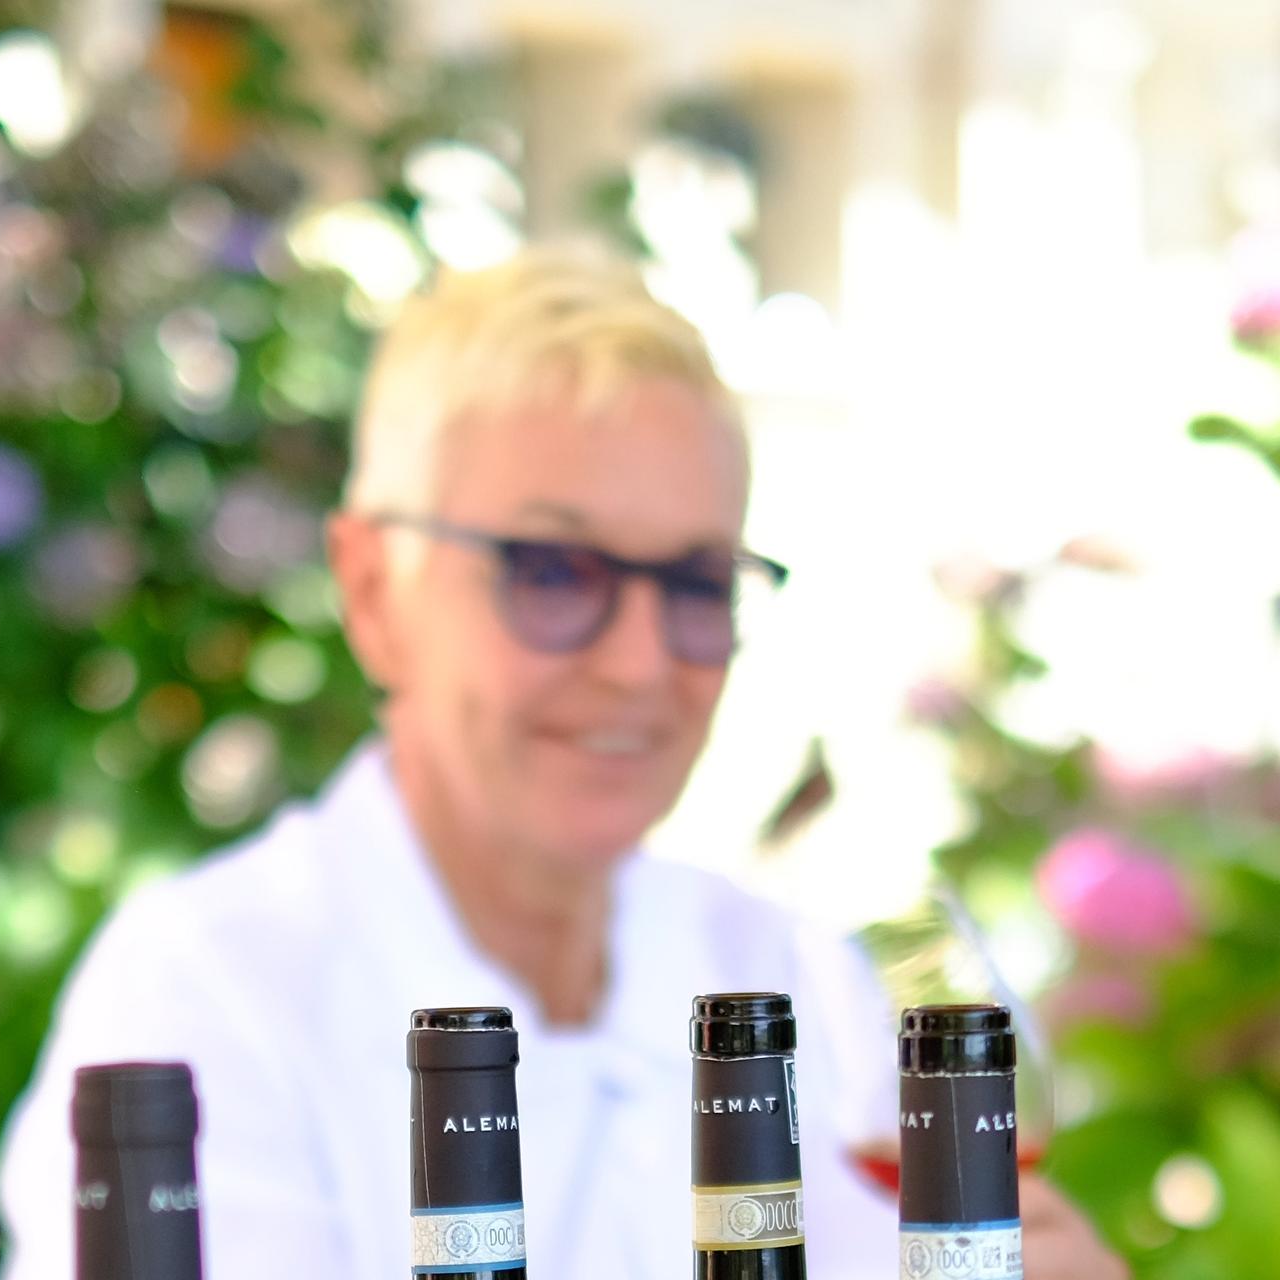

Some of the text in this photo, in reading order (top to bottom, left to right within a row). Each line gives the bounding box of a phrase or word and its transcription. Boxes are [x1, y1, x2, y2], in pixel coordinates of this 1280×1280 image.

[693, 1097, 776, 1113] ALEMAT
[443, 1116, 519, 1133] ALEMA
[489, 1226, 511, 1246] DOC
[943, 1249, 972, 1270] DOC
